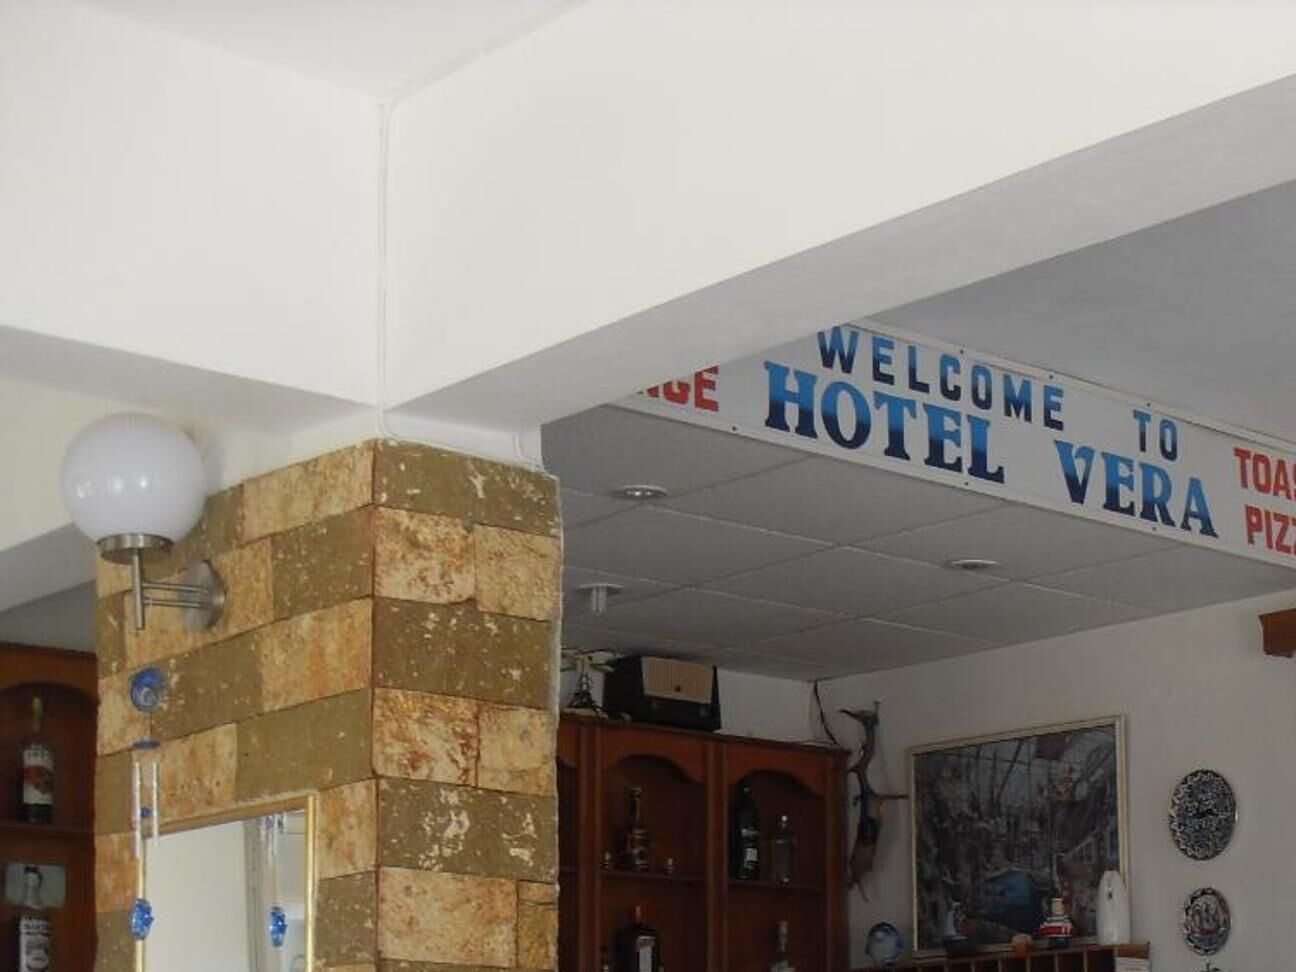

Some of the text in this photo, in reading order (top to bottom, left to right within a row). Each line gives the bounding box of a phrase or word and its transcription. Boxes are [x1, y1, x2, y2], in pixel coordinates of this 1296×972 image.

[763, 360, 1218, 538] HOTEL VERA
[818, 326, 1179, 461] WELCOME TO
